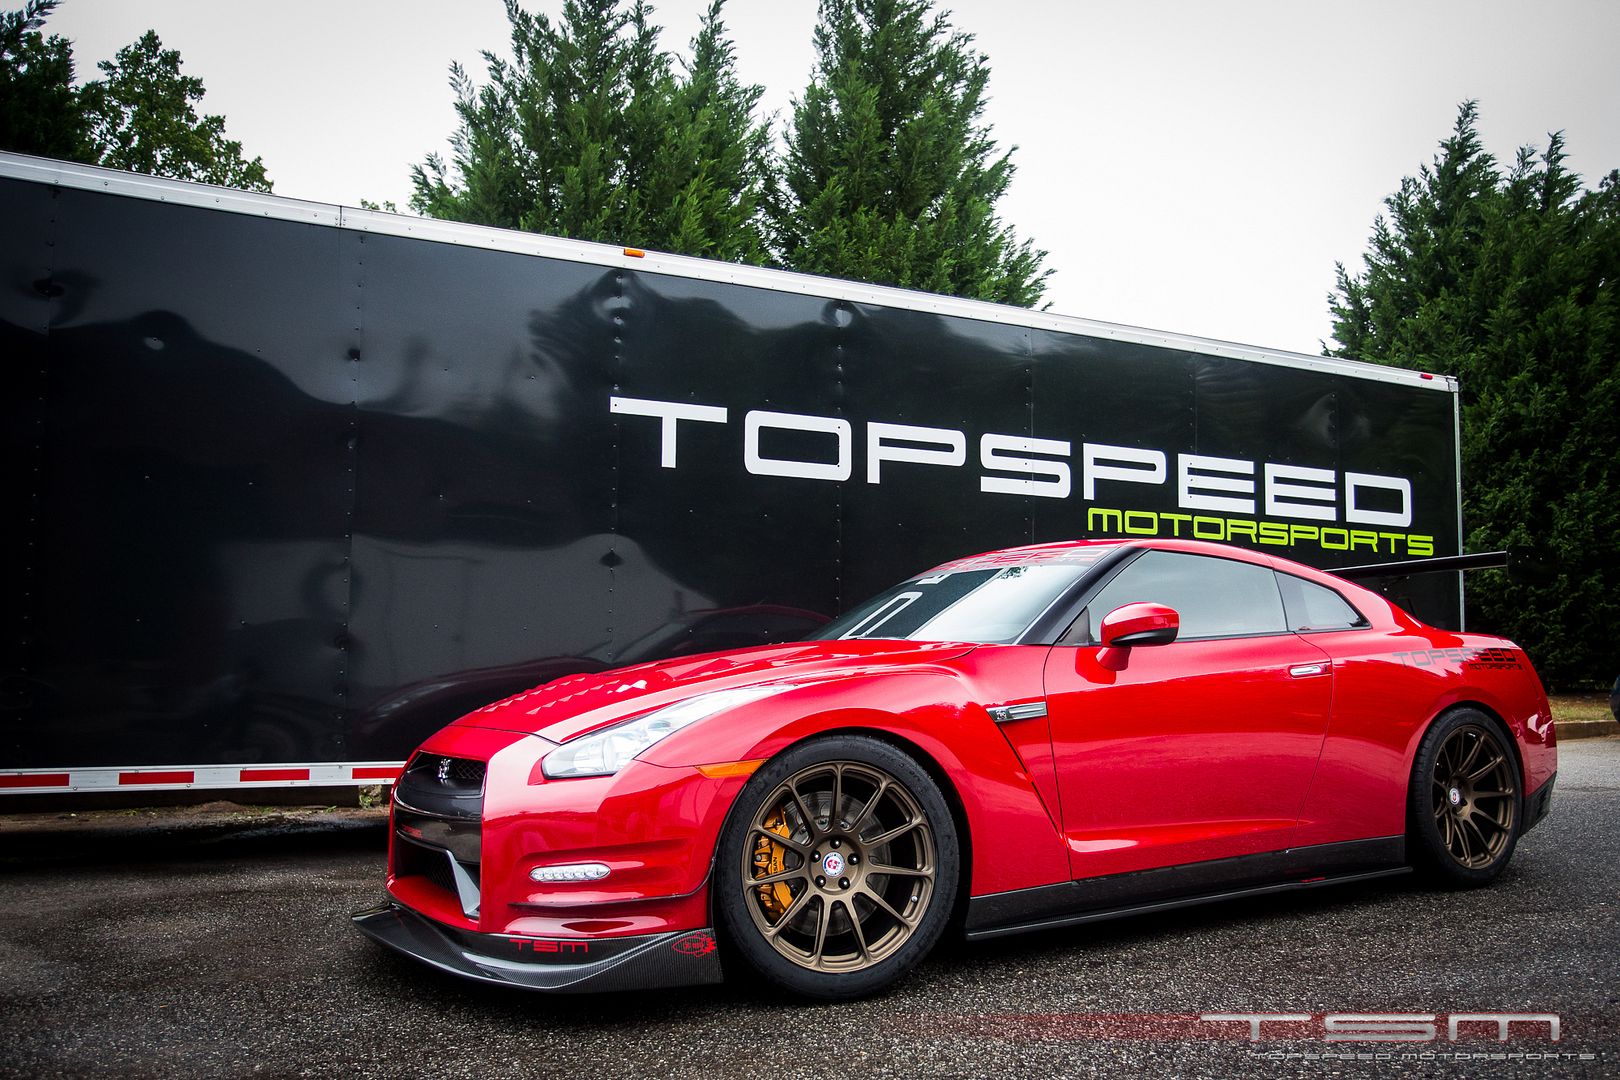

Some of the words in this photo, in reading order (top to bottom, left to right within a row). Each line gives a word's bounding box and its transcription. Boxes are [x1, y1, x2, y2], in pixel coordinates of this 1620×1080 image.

[610, 396, 1413, 528] TOPSPEED
[1087, 506, 1435, 556] MOTORSPORTS
[1392, 647, 1517, 668] TOPSPEED
[508, 938, 589, 953] TSM
